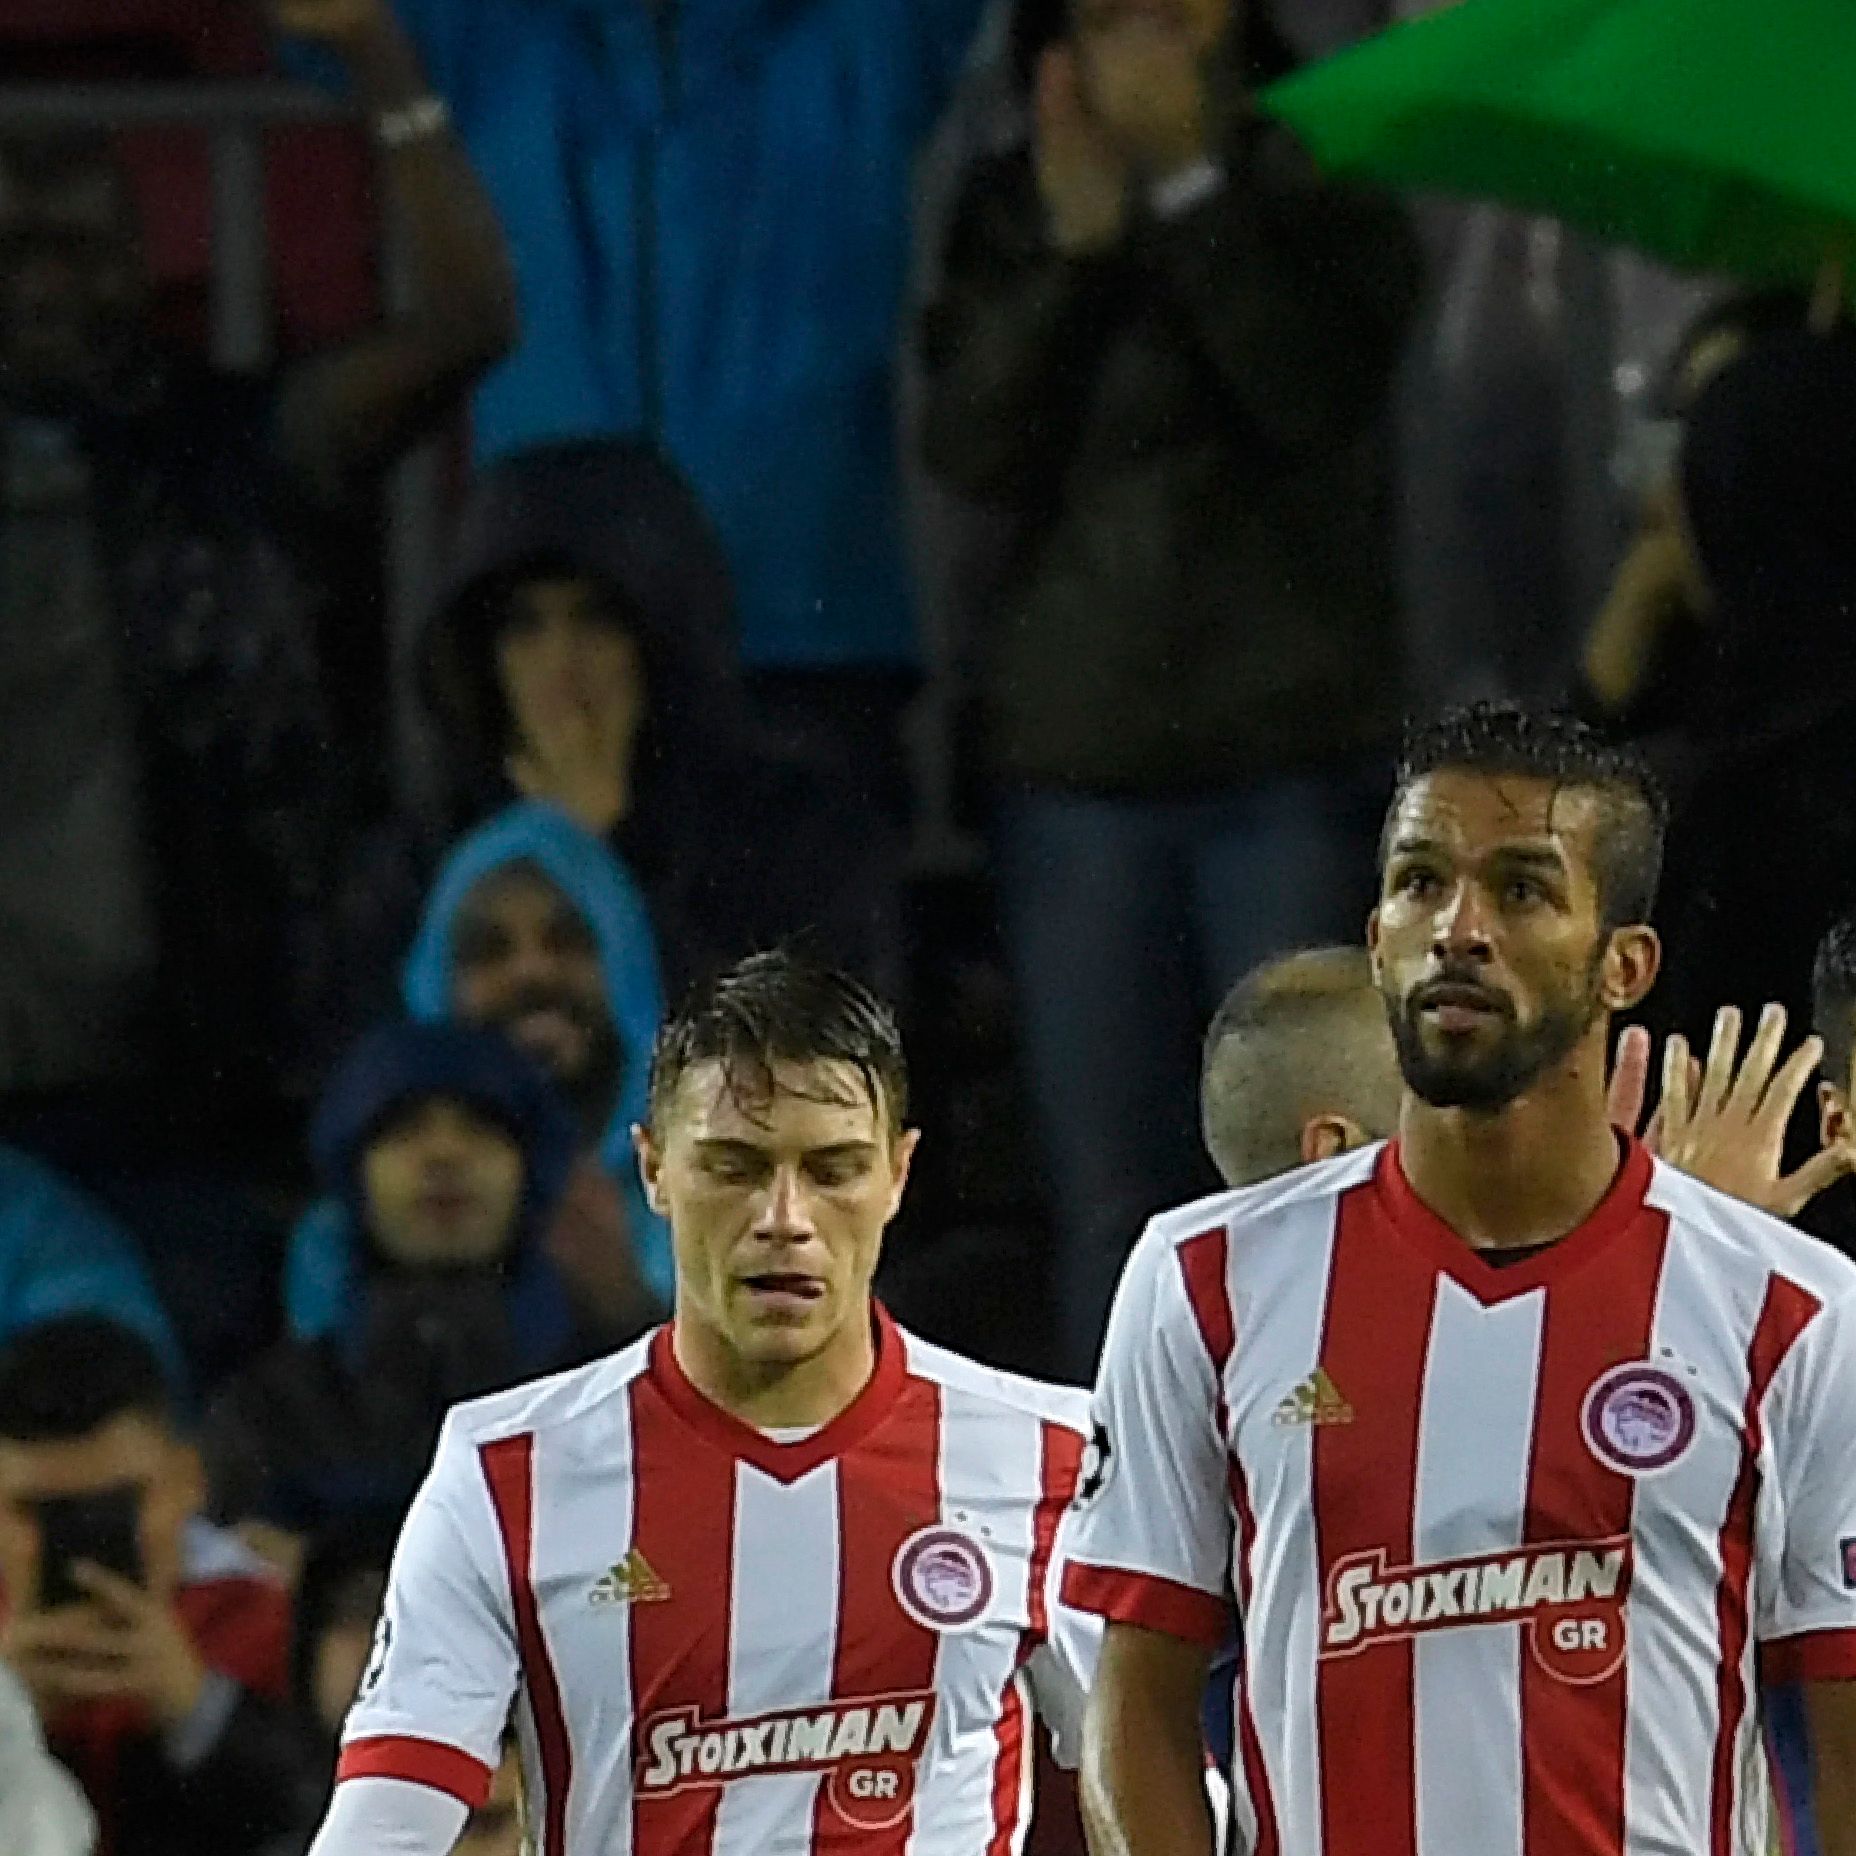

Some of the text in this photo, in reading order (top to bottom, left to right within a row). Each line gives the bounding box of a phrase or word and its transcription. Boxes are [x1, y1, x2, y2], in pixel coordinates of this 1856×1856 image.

[1327, 1547, 1626, 1644] STOIXIMAN
[1553, 1617, 1608, 1651] GR
[643, 1699, 925, 1787] STOIXIMAN
[849, 1768, 899, 1799] GR
